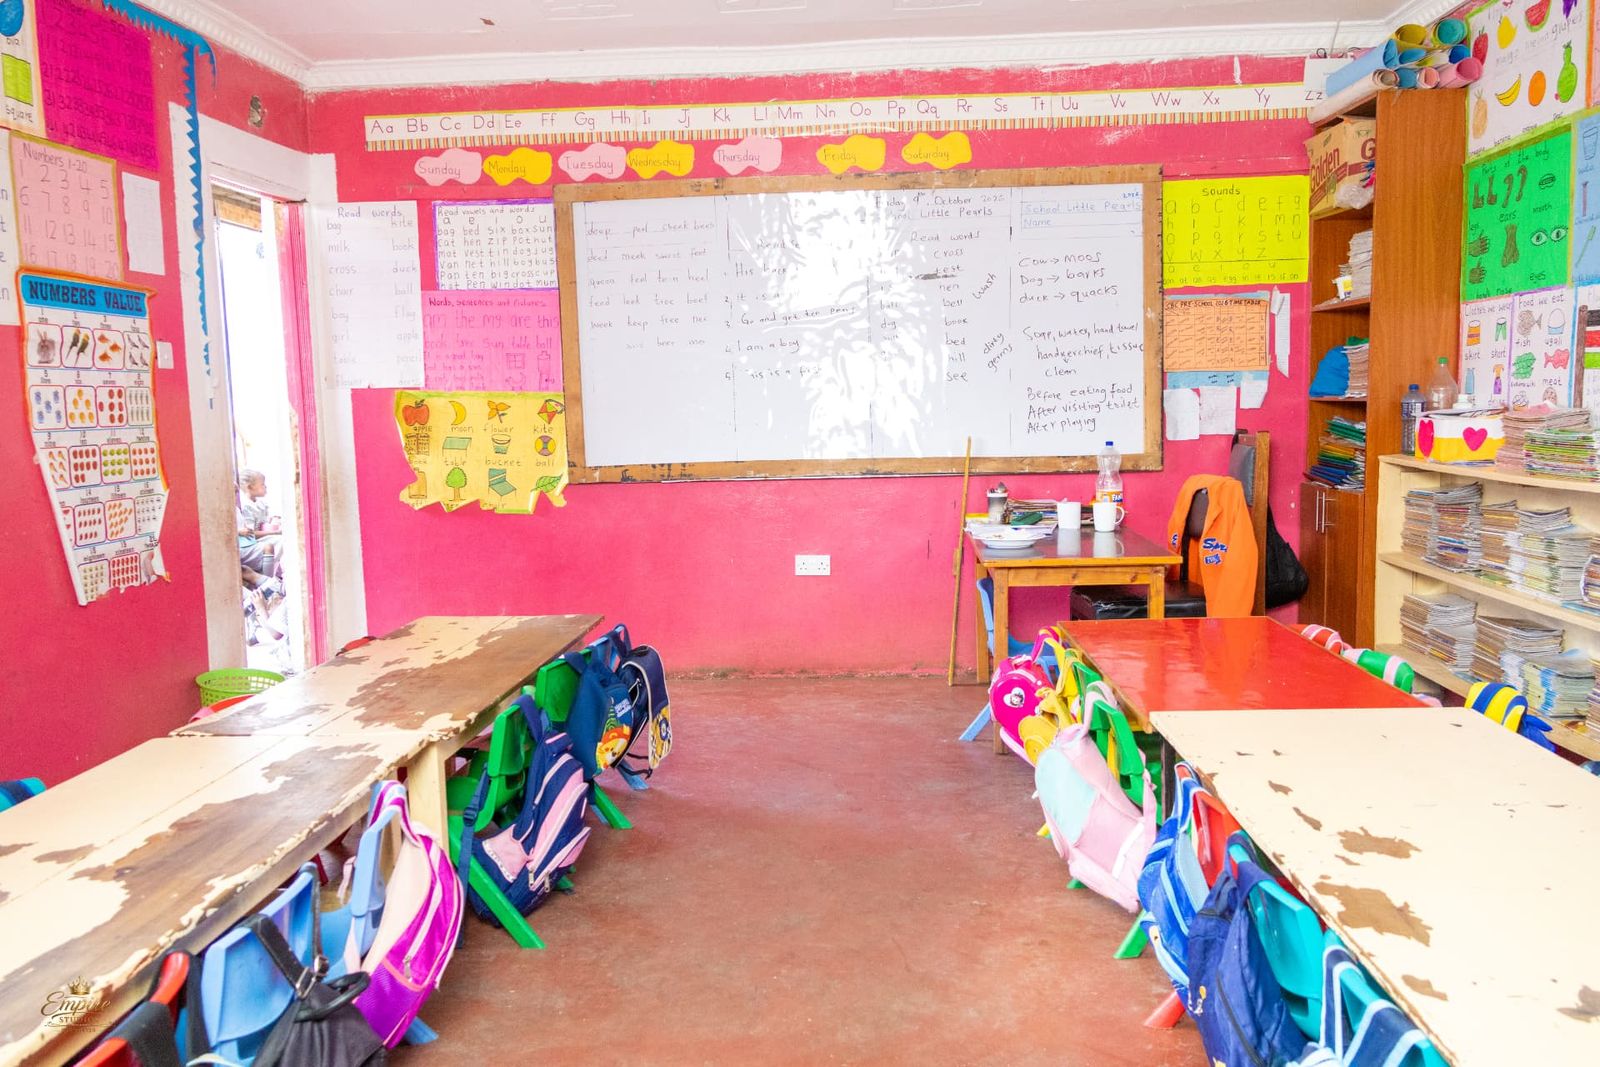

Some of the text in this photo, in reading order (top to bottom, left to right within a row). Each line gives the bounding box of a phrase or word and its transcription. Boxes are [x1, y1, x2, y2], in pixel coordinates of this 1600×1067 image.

[371, 119, 393, 134] Aa
[407, 118, 428, 132] Bb
[440, 117, 461, 130] Cc
[473, 115, 495, 129] Dd
[505, 114, 521, 128] Ee
[541, 113, 556, 127] Ff
[574, 112, 595, 130] Gg
[611, 110, 630, 124] Hh
[678, 108, 690, 128] Jj
[713, 107, 731, 122] Kk
[777, 106, 802, 119] Mm
[815, 104, 835, 118] Nn
[850, 102, 872, 116] Oo
[887, 100, 906, 119] Pp
[917, 100, 940, 118] Qq
[957, 99, 972, 113] Rr
[994, 98, 1008, 112] Ss
[1031, 96, 1045, 111] Tt
[1061, 97, 1079, 110] Uu
[1110, 95, 1126, 108] Vv
[1151, 93, 1181, 106] Ww
[1203, 92, 1220, 105] Xx
[1254, 88, 1270, 106] Yy
[1305, 90, 1323, 101] Zz
[23, 143, 64, 167] Numbers
[628, 153, 681, 170] Wednesday
[717, 149, 760, 165] Thursday
[823, 148, 857, 162] Friday
[903, 147, 949, 160] Saturday
[418, 160, 461, 178] Sunday
[488, 161, 526, 176] Monday
[565, 156, 614, 174] Tuesday
[337, 206, 403, 218] Read words
[920, 209, 950, 218] Little
[959, 207, 993, 217] Pearls
[1066, 267, 1105, 279] barks
[28, 280, 142, 312] NUMBERS VALUE
[1070, 285, 1118, 302] quacks
[1070, 387, 1107, 403] eating
[1060, 417, 1096, 432] playing
